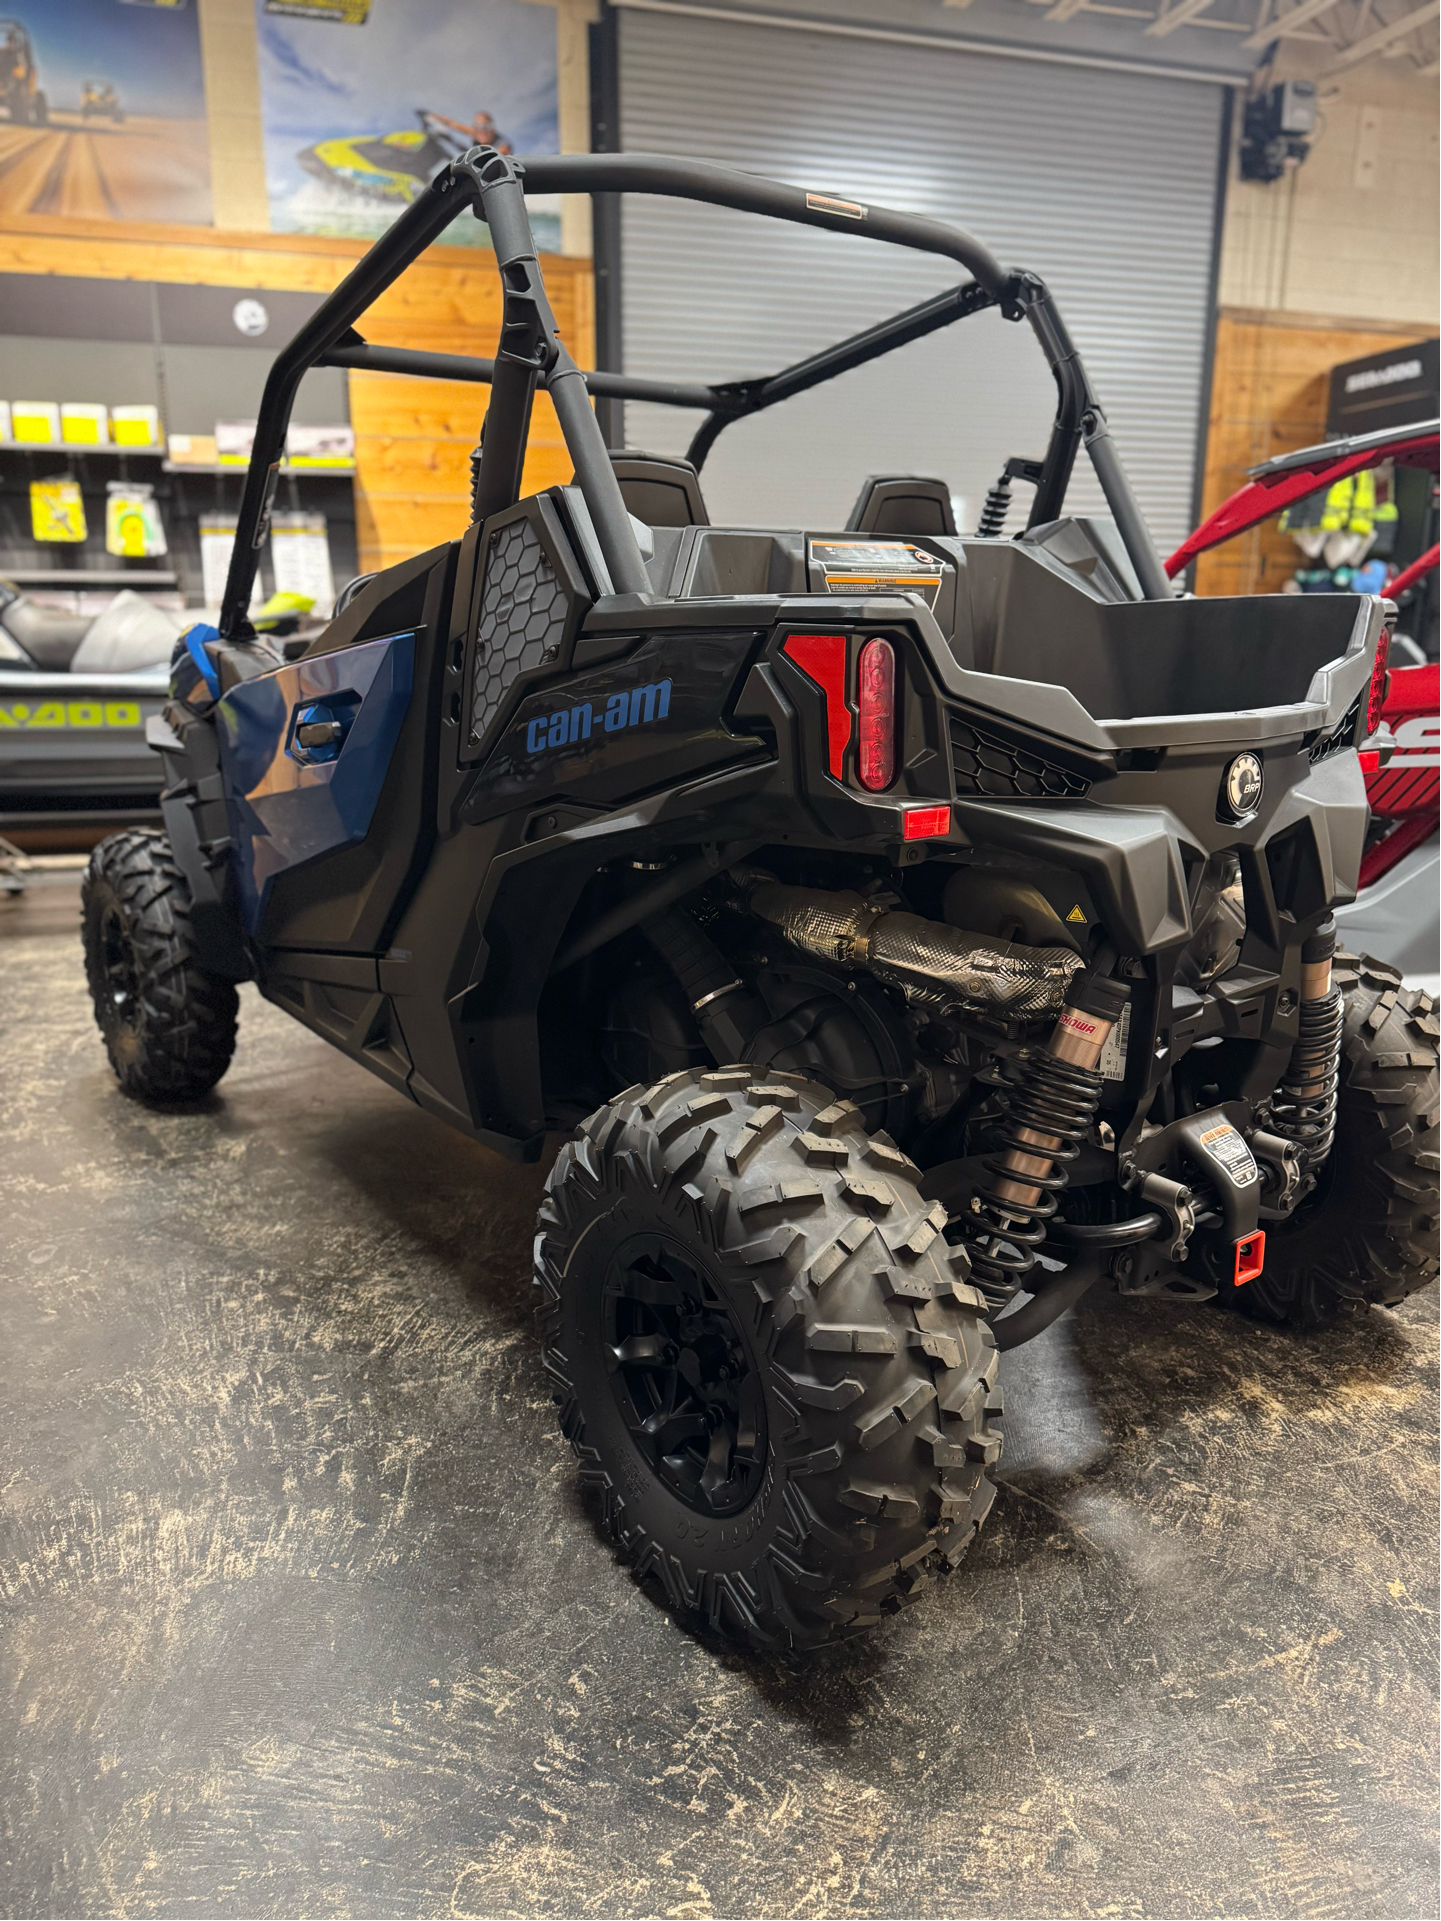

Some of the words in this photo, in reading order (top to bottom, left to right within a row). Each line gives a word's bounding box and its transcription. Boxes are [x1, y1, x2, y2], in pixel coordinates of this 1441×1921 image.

[526, 679, 673, 754] can-am
[1243, 782, 1261, 794] BRP
[1059, 1013, 1097, 1034] SHOWA
